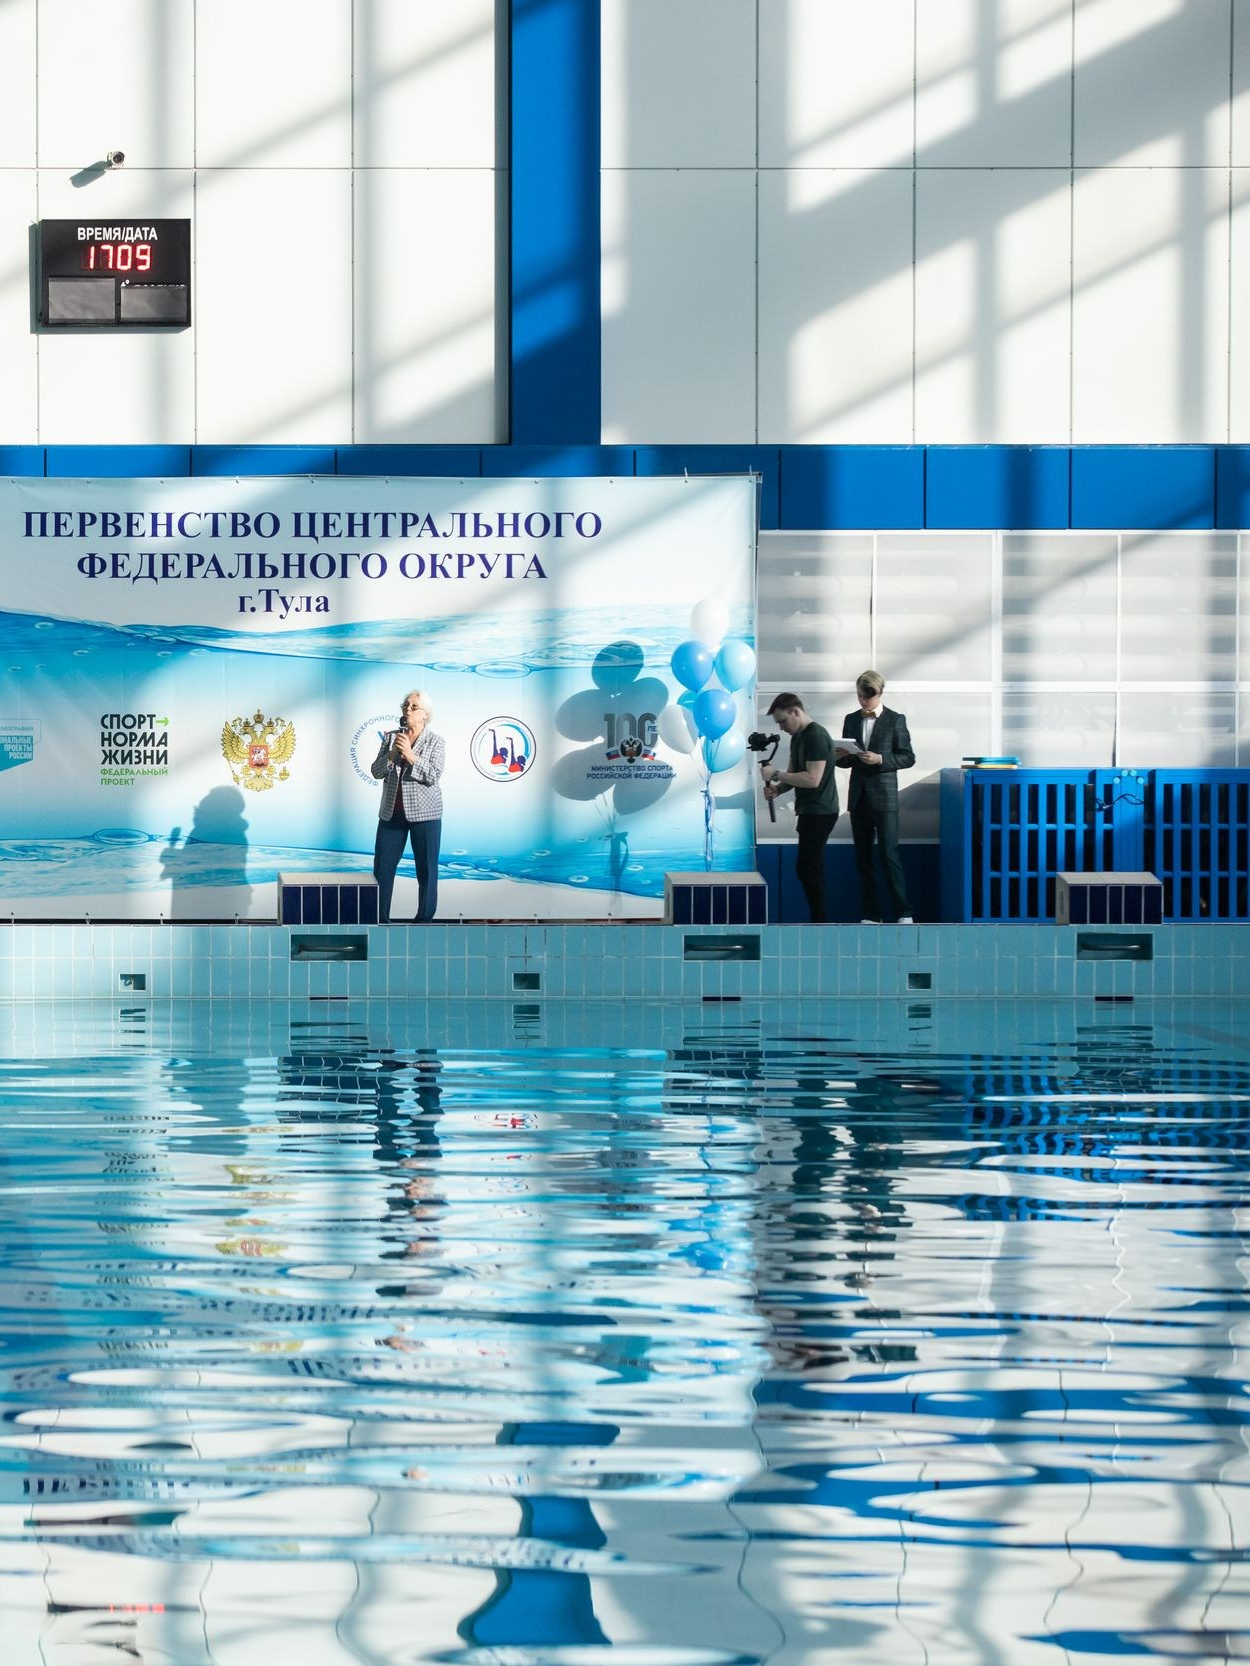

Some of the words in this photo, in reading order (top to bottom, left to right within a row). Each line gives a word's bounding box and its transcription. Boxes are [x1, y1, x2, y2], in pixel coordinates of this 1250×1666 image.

[77, 227, 158, 242] ВРЕМЯ/ДАТА
[89, 244, 151, 270] 1709
[22, 511, 281, 539] ПЕРВЕНСТВО
[292, 511, 602, 545] ЦЕНТРАЛЬНОГО
[77, 552, 388, 585] ФЕДЕРАЛЬНОГО
[399, 552, 549, 580] ОКРУГА
[238, 588, 330, 617] г.Тула
[100, 713, 156, 730] СПОРТ
[647, 725, 658, 733] ЛЕ
[352, 715, 401, 745] СИНХРОННОГО
[100, 731, 168, 747] НОРМА
[3, 744, 33, 752] ПРОЕКТЫ
[8, 752, 33, 760] РОССИИ
[100, 749, 168, 765] ЖИЗНИ
[100, 767, 168, 776] ФЕДЕРАЛЬНЫЙ
[350, 747, 379, 787] ФЕДЕРАЦИЯ
[100, 778, 135, 786] ПРОЕКТ
